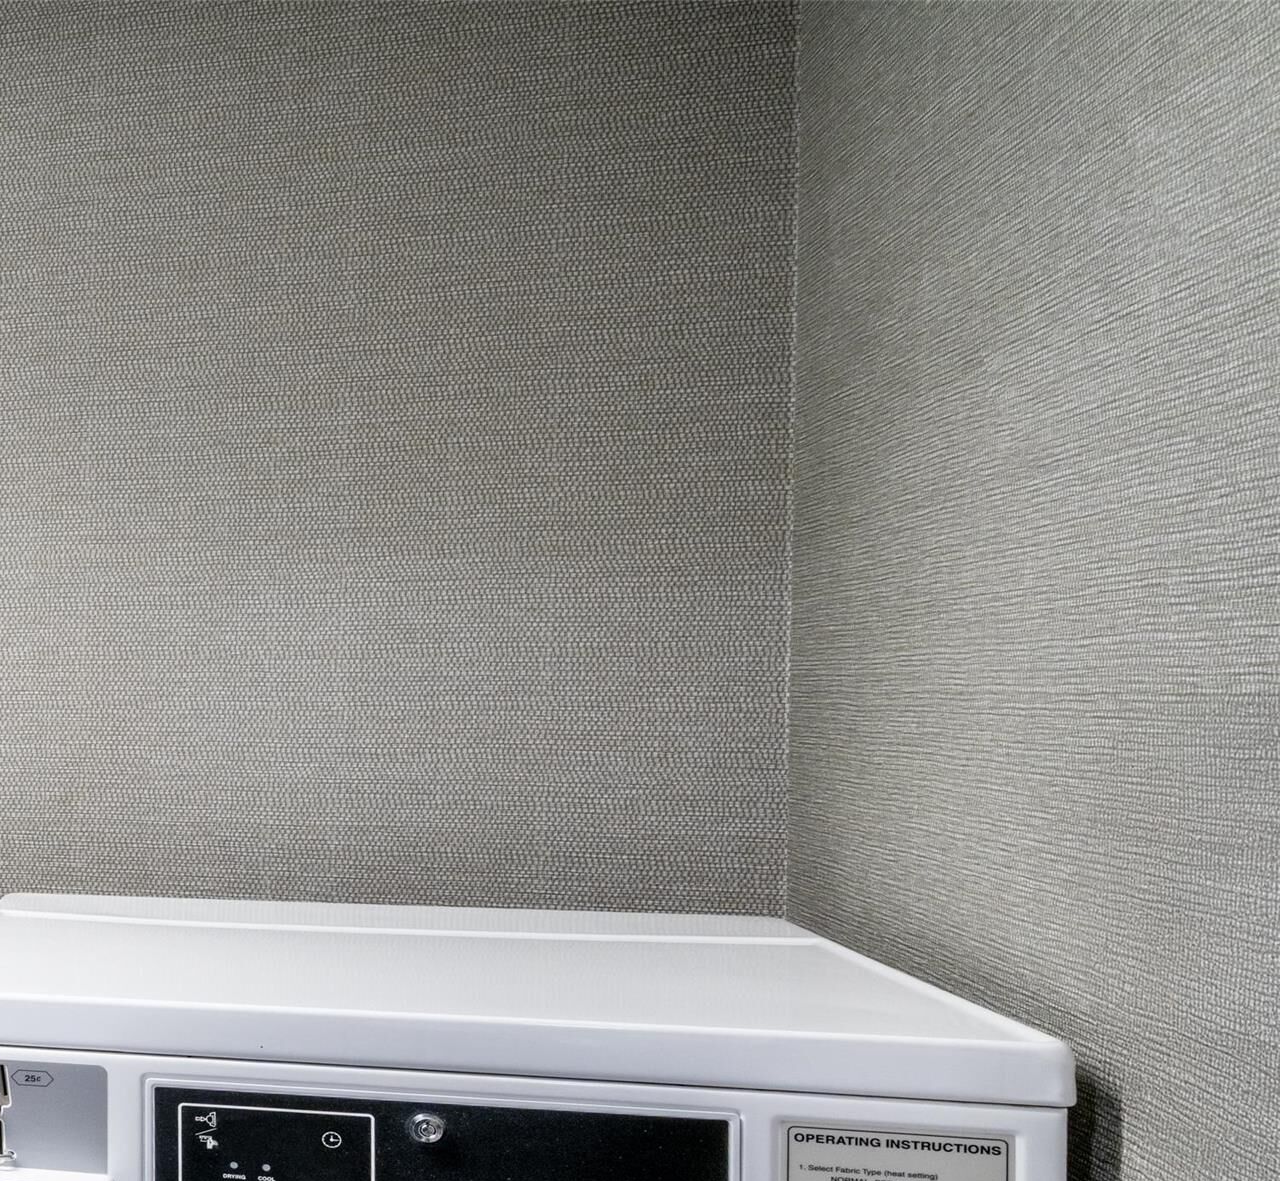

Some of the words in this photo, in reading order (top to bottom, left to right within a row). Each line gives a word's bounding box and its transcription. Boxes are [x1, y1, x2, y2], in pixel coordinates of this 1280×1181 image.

[794, 1132, 881, 1148] OPERATING
[886, 1140, 1002, 1156] INSTRUCTIONS
[835, 1166, 860, 1174] Fabric
[863, 1168, 881, 1176] Type
[884, 1169, 905, 1178] (heat
[907, 1172, 938, 1181] setting)
